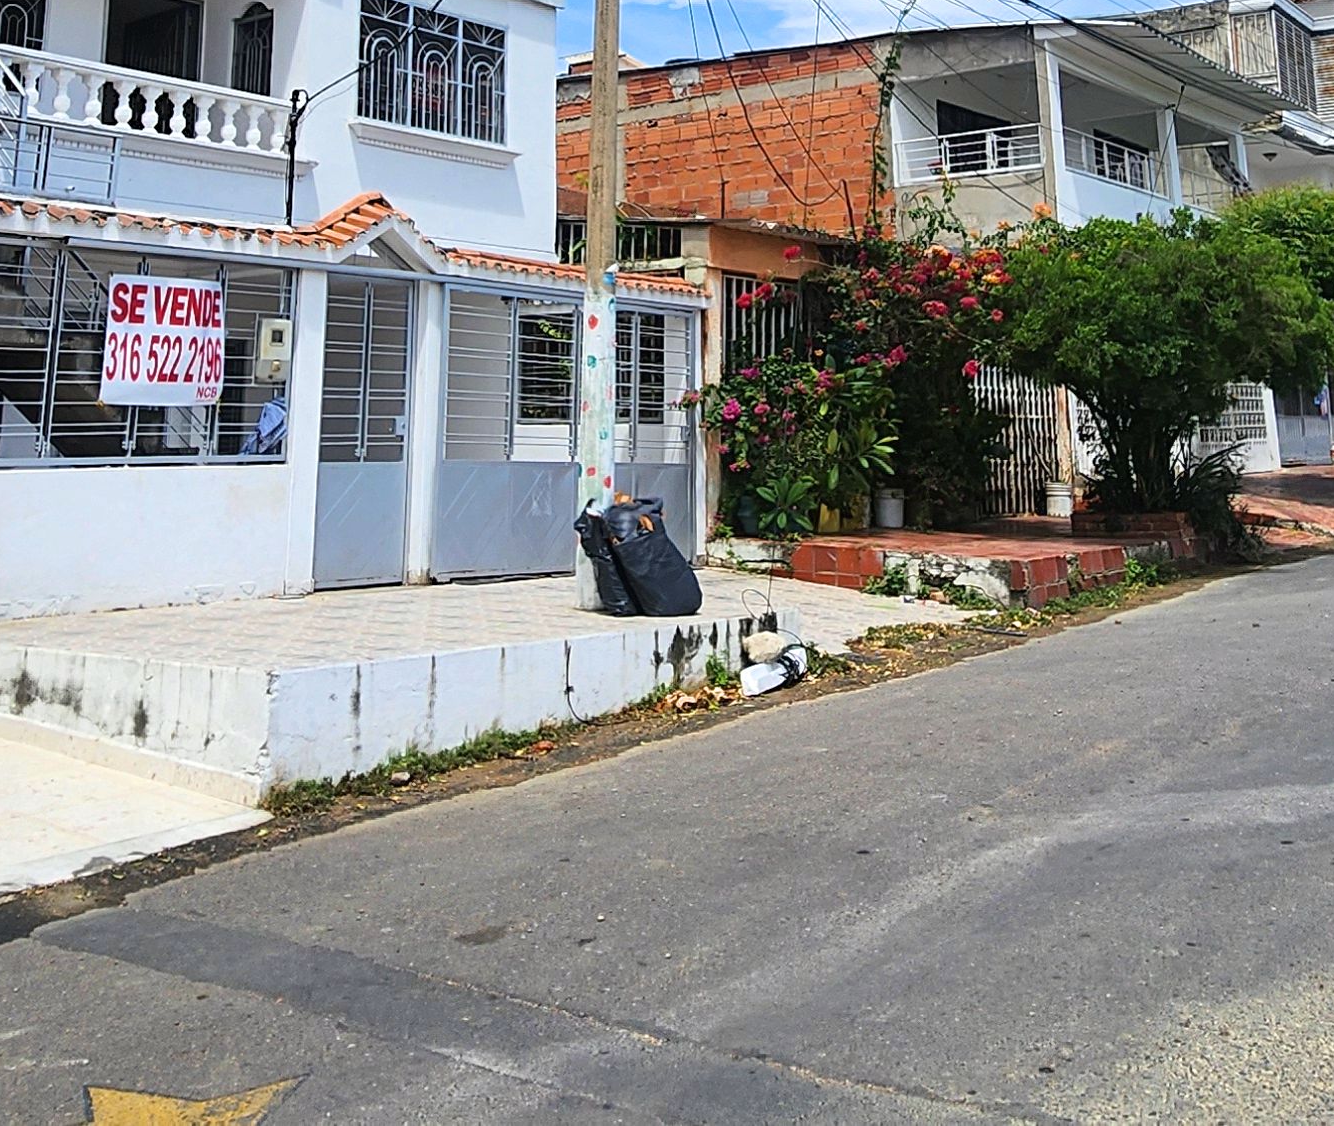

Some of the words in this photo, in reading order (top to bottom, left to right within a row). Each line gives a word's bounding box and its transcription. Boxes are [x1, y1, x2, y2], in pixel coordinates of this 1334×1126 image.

[110, 282, 149, 324] SE
[153, 285, 222, 328] VENDE
[105, 332, 142, 382] 316
[146, 334, 183, 383] 522
[183, 336, 222, 384] 2196
[195, 386, 218, 399] NCB
